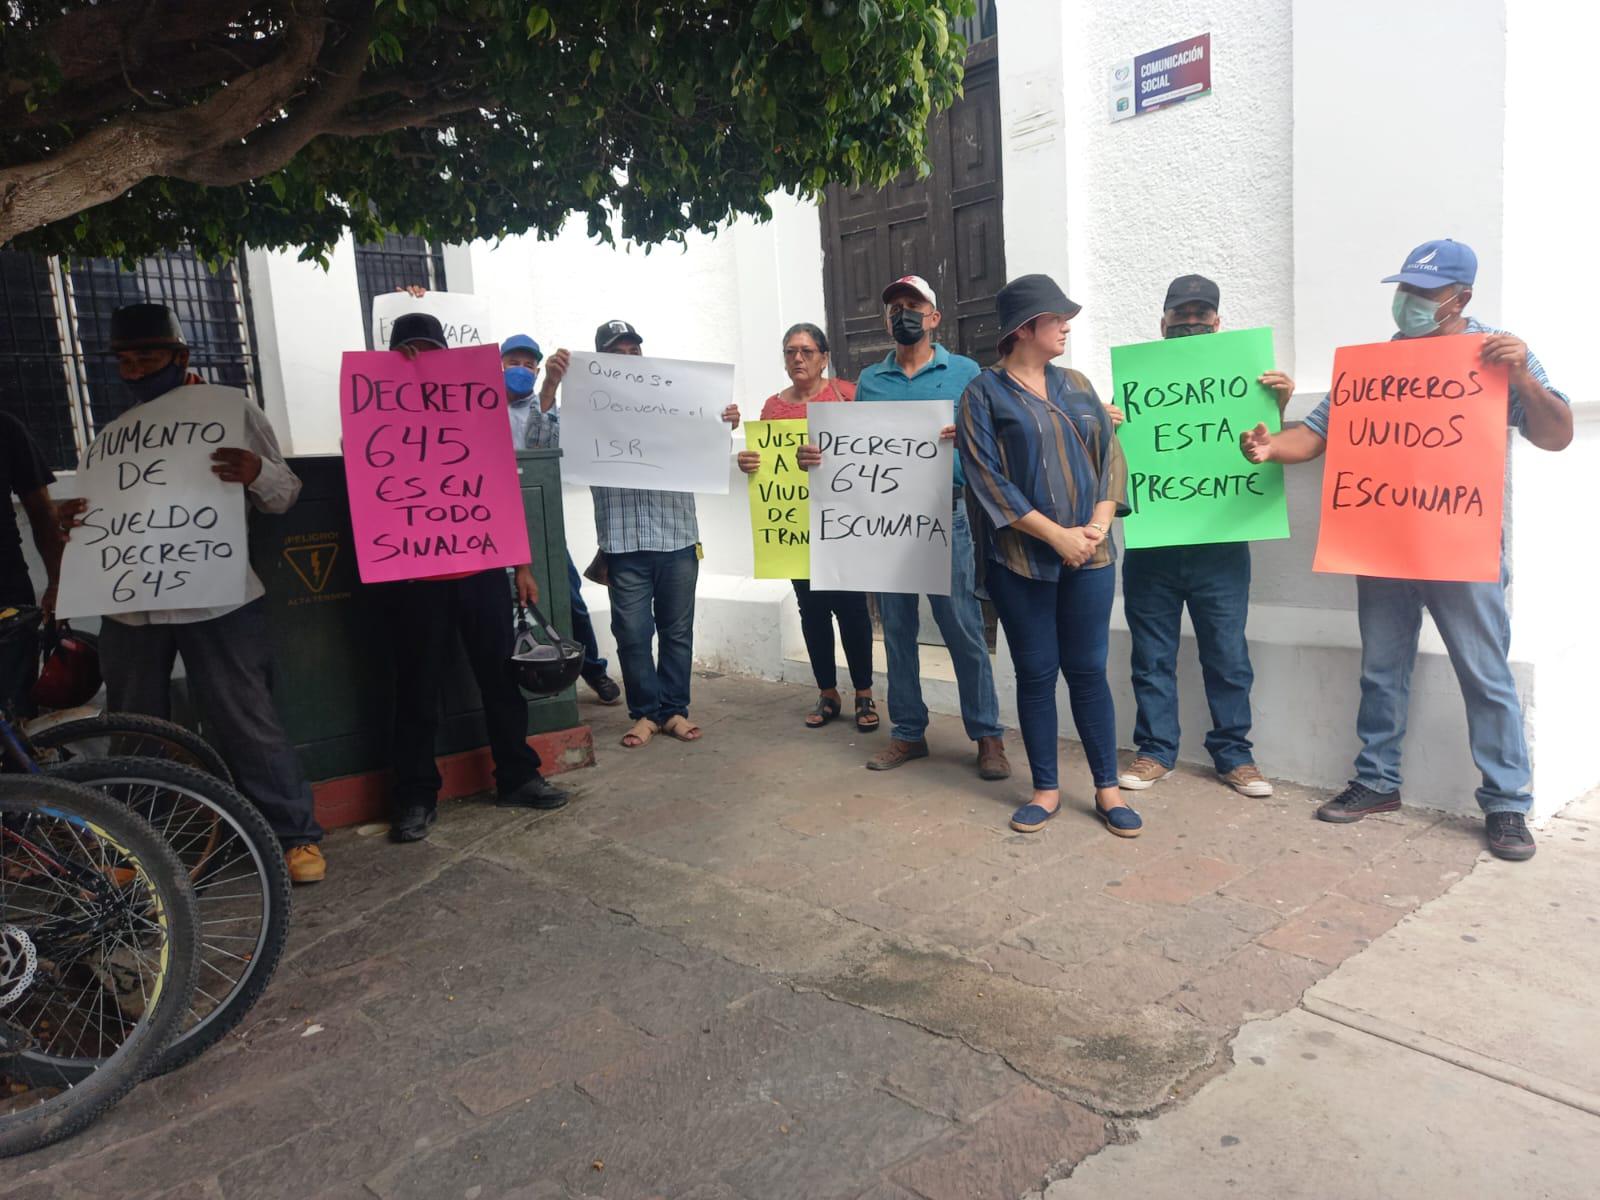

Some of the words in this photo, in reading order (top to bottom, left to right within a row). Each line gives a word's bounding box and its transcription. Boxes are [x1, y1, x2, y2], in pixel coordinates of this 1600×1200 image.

[1141, 46, 1203, 77] COMUNICACIÓN
[1141, 74, 1170, 94] SOCIAL
[351, 373, 499, 415] DECRETO
[1122, 375, 1248, 423] ROSARIO
[1333, 370, 1483, 406] GUERREROS
[86, 420, 225, 470] AUMENTO
[365, 424, 470, 468] 645
[818, 431, 938, 459] DECRETO
[1154, 417, 1234, 453] ESTA
[1350, 414, 1465, 448] UNIDOS
[119, 459, 167, 490] DE
[774, 454, 789, 475] A
[831, 463, 902, 494] 645
[375, 475, 427, 503] ES
[440, 474, 483, 498] EN
[1130, 472, 1265, 514] PRESENTE
[1332, 471, 1483, 517] ESCUINAPA
[81, 504, 218, 546] SUELDO
[394, 504, 491, 526] TODO
[768, 507, 798, 524] DE
[102, 540, 232, 571] DECRETO
[371, 532, 498, 563] SINALOA
[112, 569, 191, 602] 645
